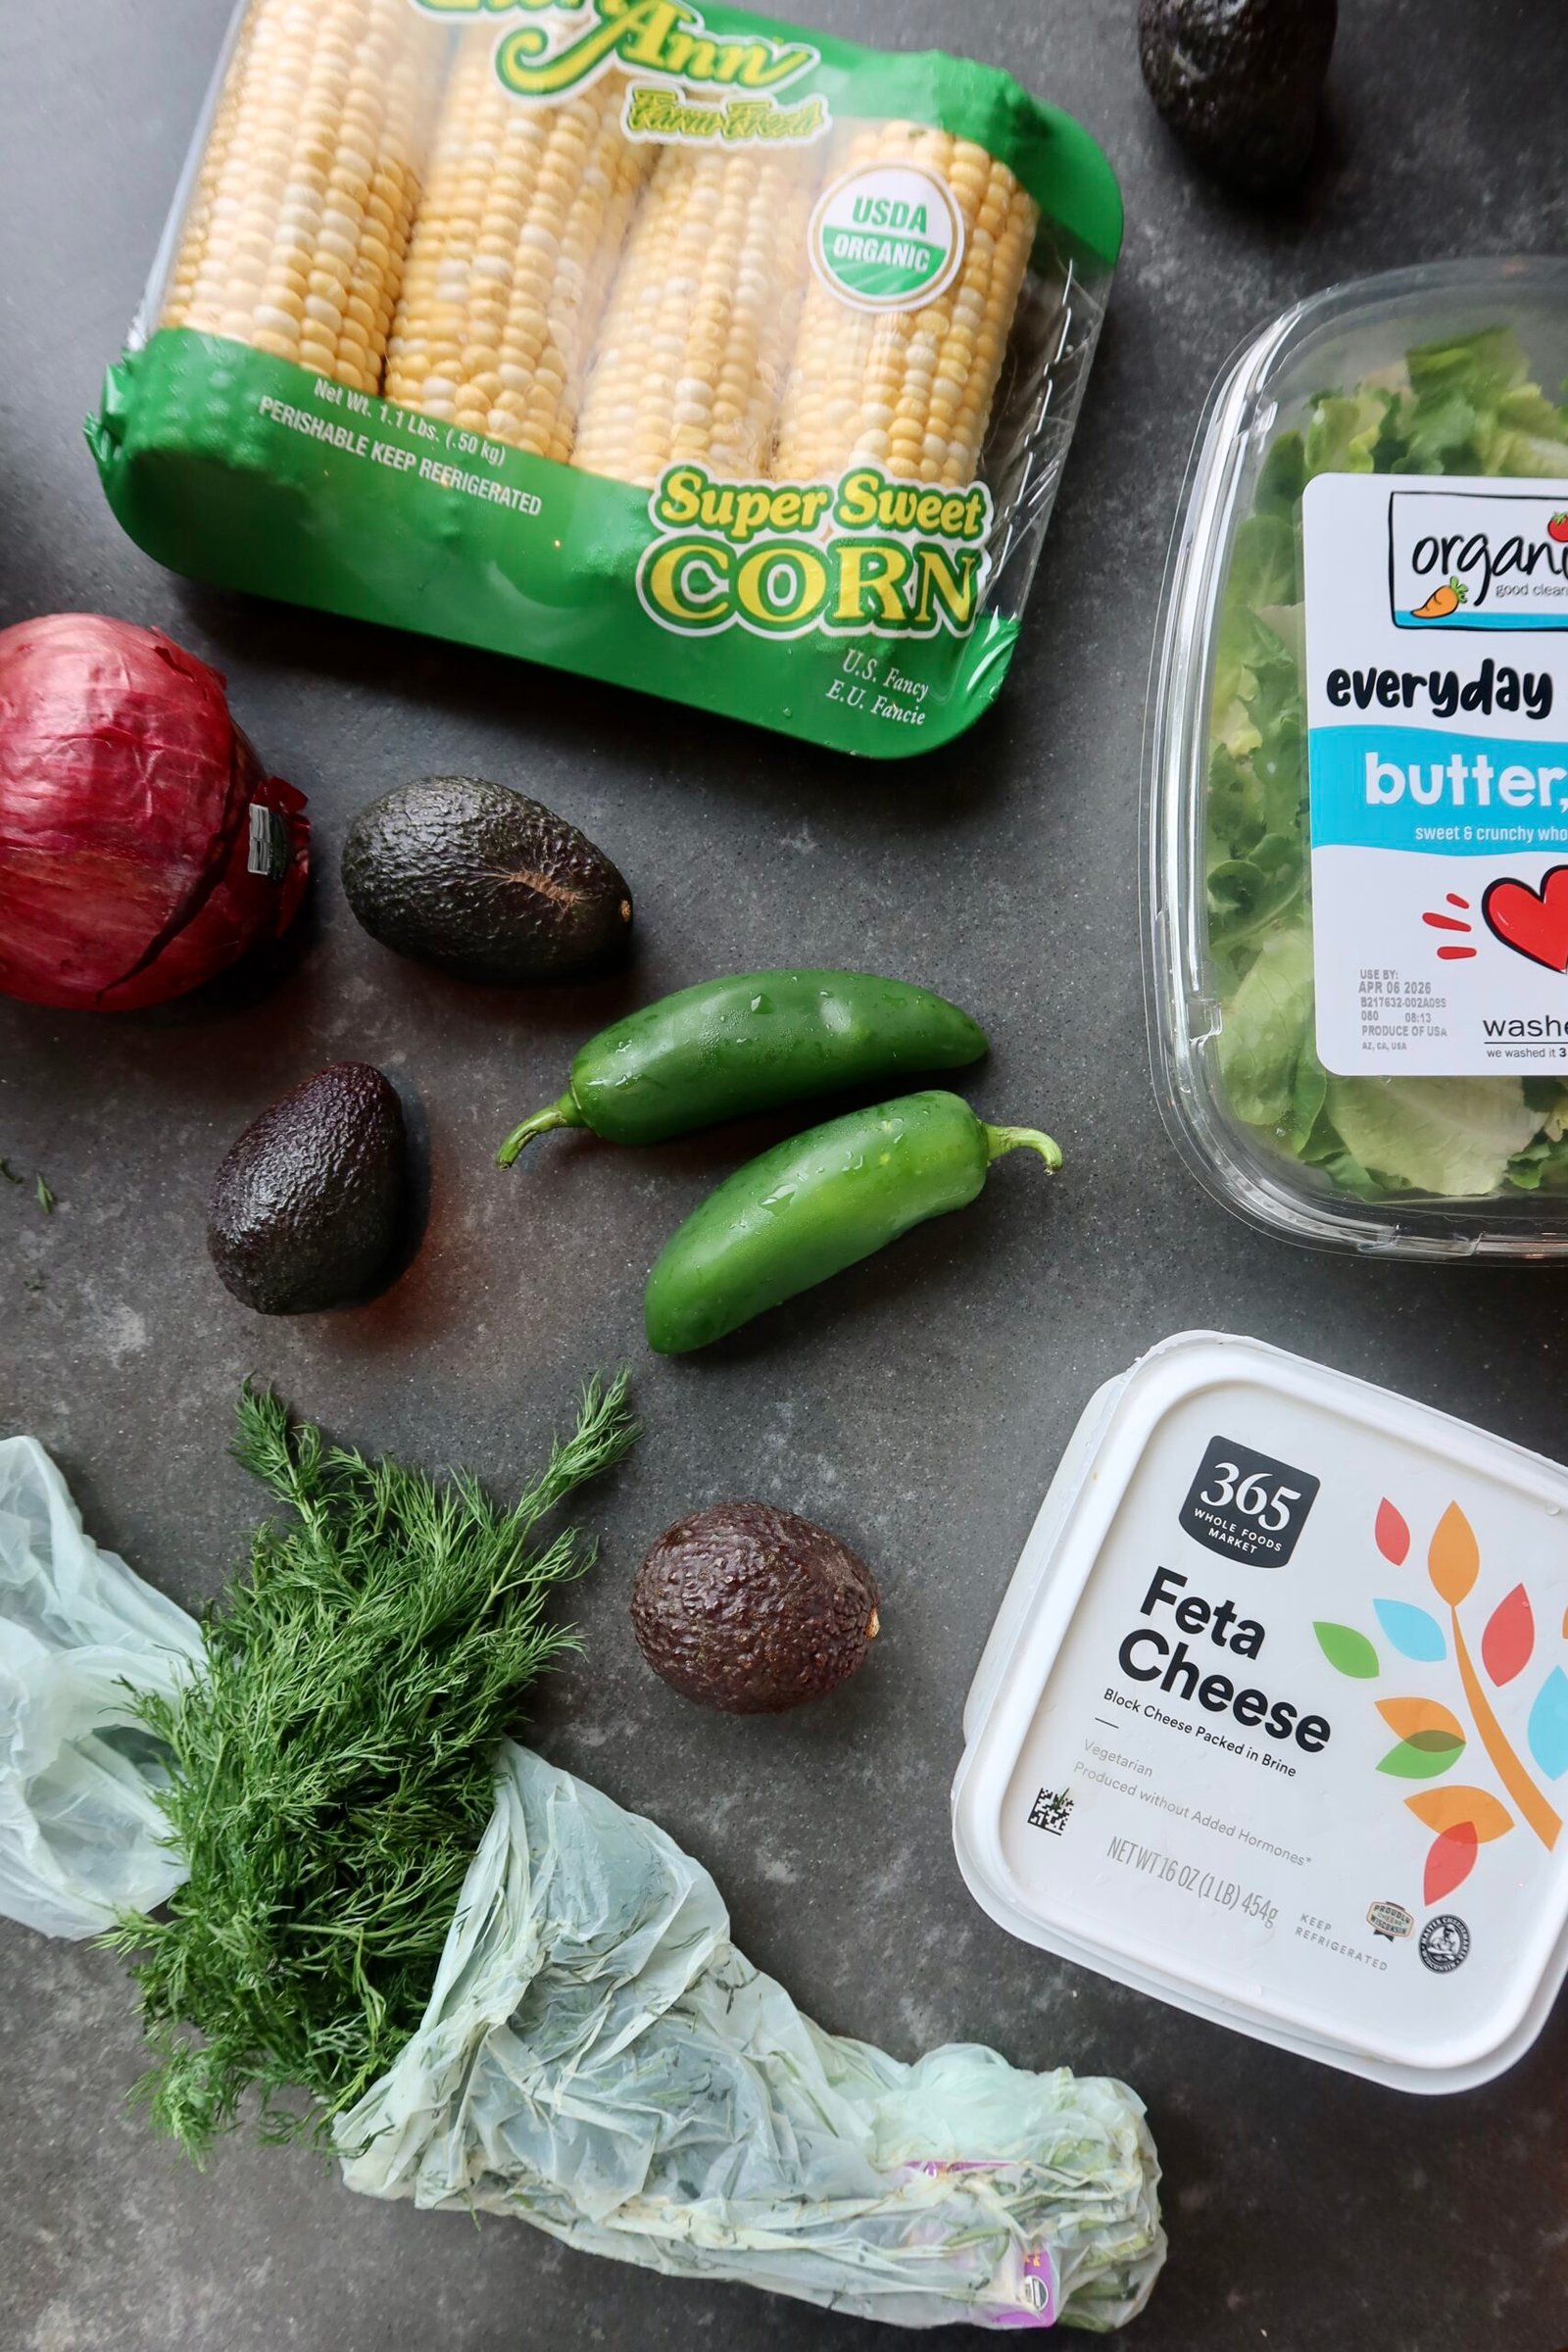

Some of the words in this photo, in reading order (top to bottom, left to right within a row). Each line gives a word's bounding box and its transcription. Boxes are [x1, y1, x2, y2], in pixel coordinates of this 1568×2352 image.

[496, 0, 815, 93] Ann
[852, 195, 928, 236] USDA
[832, 232, 931, 274] ORGANIC
[314, 376, 344, 405] Net
[346, 390, 372, 418] Wt.
[378, 403, 404, 429] 1.1
[407, 413, 441, 443] Lbs.
[445, 427, 479, 456] (.50
[479, 443, 507, 467] kg)
[257, 394, 370, 459] PERISHABLE
[370, 439, 417, 473] KEEP
[418, 456, 543, 517] REFRIGERATED
[659, 470, 830, 540] Super
[837, 471, 984, 537] Sweet
[647, 540, 980, 627] CORN
[1495, 583, 1529, 598] good
[842, 647, 877, 684] U.S.
[883, 666, 930, 703] Fancy
[1325, 657, 1554, 720] everyday
[825, 678, 864, 710] E.U.
[870, 695, 927, 727] Fancie
[1364, 751, 1568, 814] butter,
[1414, 825, 1460, 842] sweet
[1463, 825, 1473, 842] &
[1476, 825, 1535, 844] crunchy
[1538, 825, 1568, 842] who
[1358, 981, 1383, 994] APR
[1386, 981, 1400, 994] 06
[1403, 981, 1432, 995] 2026
[1359, 968, 1380, 980] USE
[1382, 969, 1398, 980] BY:
[1361, 1010, 1379, 1021] 080
[1404, 1012, 1432, 1023] 08:13
[1361, 1025, 1409, 1037] PRODUCE
[1411, 1025, 1425, 1037] OF
[1427, 1025, 1447, 1037] USA
[1391, 1041, 1407, 1051] USA
[1487, 1050, 1502, 1058] we
[1504, 1048, 1545, 1058] washed
[1548, 1048, 1556, 1058] it
[1559, 1047, 1567, 1057] 3
[1200, 1461, 1302, 1532] 365
[1194, 1507, 1237, 1533] WHOLE
[1241, 1528, 1283, 1552] FOODS
[1208, 1527, 1258, 1554] MARKET
[1140, 1565, 1266, 1660] Feta
[1118, 1628, 1332, 1753] Cheese
[1103, 1688, 1142, 1713] Block
[1144, 1704, 1193, 1735] Cheese
[1195, 1726, 1246, 1755] Packed
[1246, 1745, 1259, 1762] in
[1261, 1753, 1298, 1778] Brine
[1084, 1738, 1153, 1778] Vegetarian
[1073, 1760, 1138, 1797] Produced
[1140, 1788, 1190, 1819] without
[1191, 1810, 1237, 1838] Added
[1106, 1836, 1139, 1865] NET
[1135, 1845, 1161, 1875] WT
[1157, 1857, 1179, 1883] 16
[1177, 1865, 1201, 1891] OZ
[1198, 1872, 1216, 1898] (1
[1213, 1880, 1241, 1911] LB)
[1241, 1891, 1279, 1930] 454g
[1299, 1912, 1333, 1933] KEEP
[1370, 1914, 1407, 1935] WISCONSIN
[1374, 1904, 1411, 1924] PROUDLY
[1421, 1918, 1442, 1945] MASTER
[1295, 1926, 1389, 1972] REFRIGERATED
